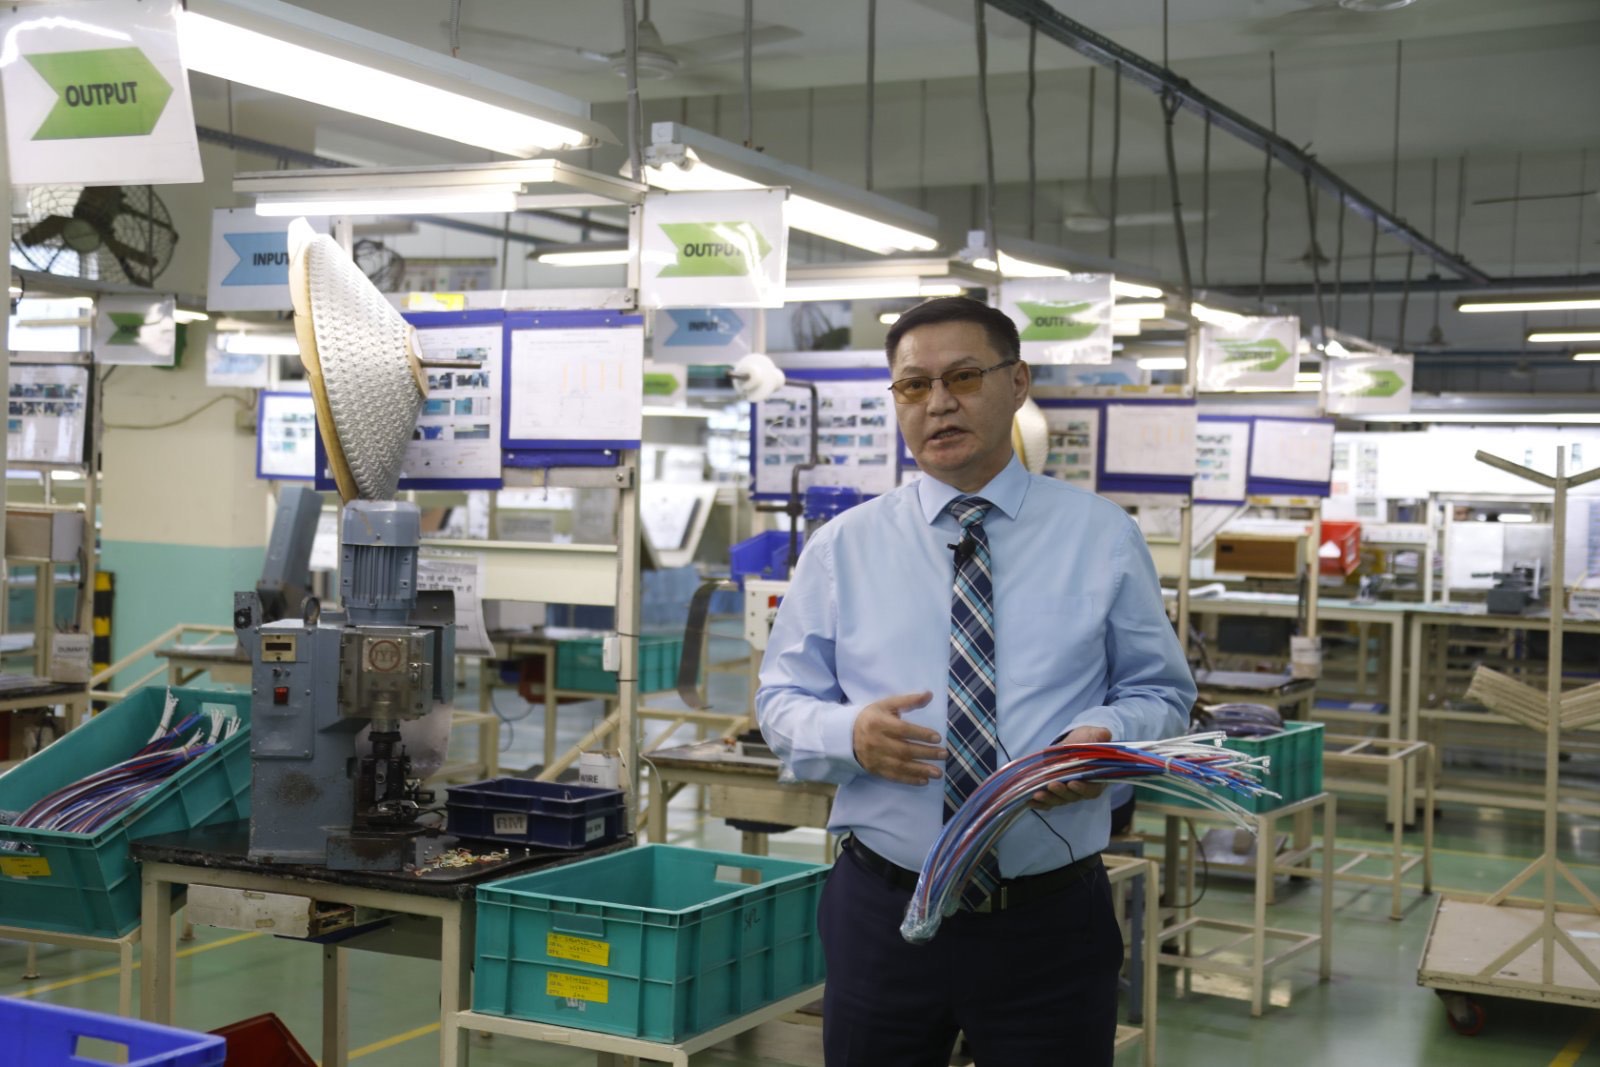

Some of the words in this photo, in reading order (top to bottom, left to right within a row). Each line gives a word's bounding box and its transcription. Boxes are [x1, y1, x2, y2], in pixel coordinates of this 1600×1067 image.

[65, 81, 138, 107] OUTPUT
[253, 252, 290, 266] INPUT
[688, 321, 718, 332] INPUT
